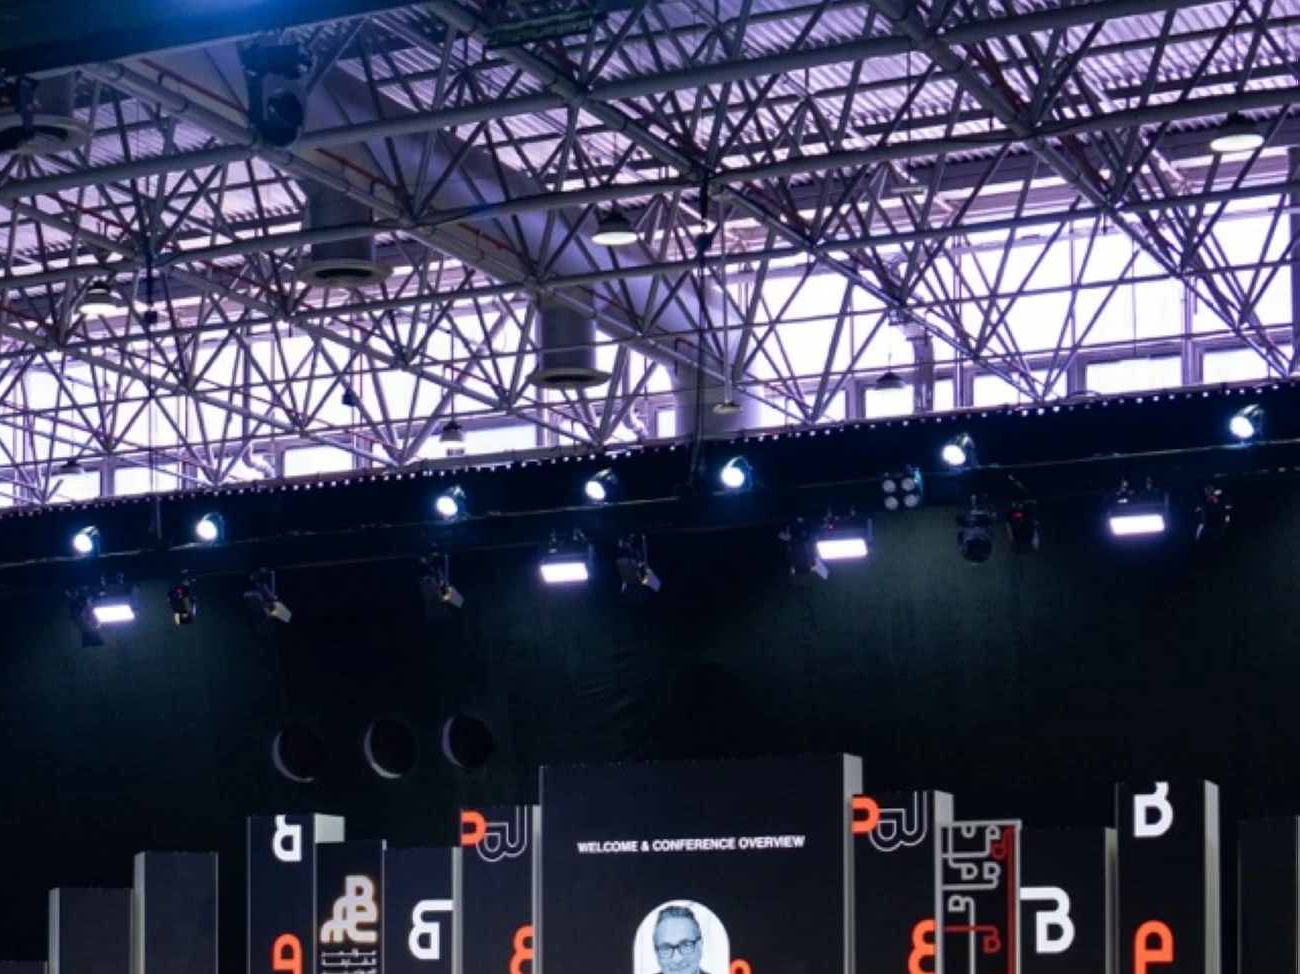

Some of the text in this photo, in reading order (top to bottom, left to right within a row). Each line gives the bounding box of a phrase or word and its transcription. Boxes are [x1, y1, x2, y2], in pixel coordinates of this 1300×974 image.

[577, 834, 806, 854] WELCOME & CONFERENCE OVERVIEW
